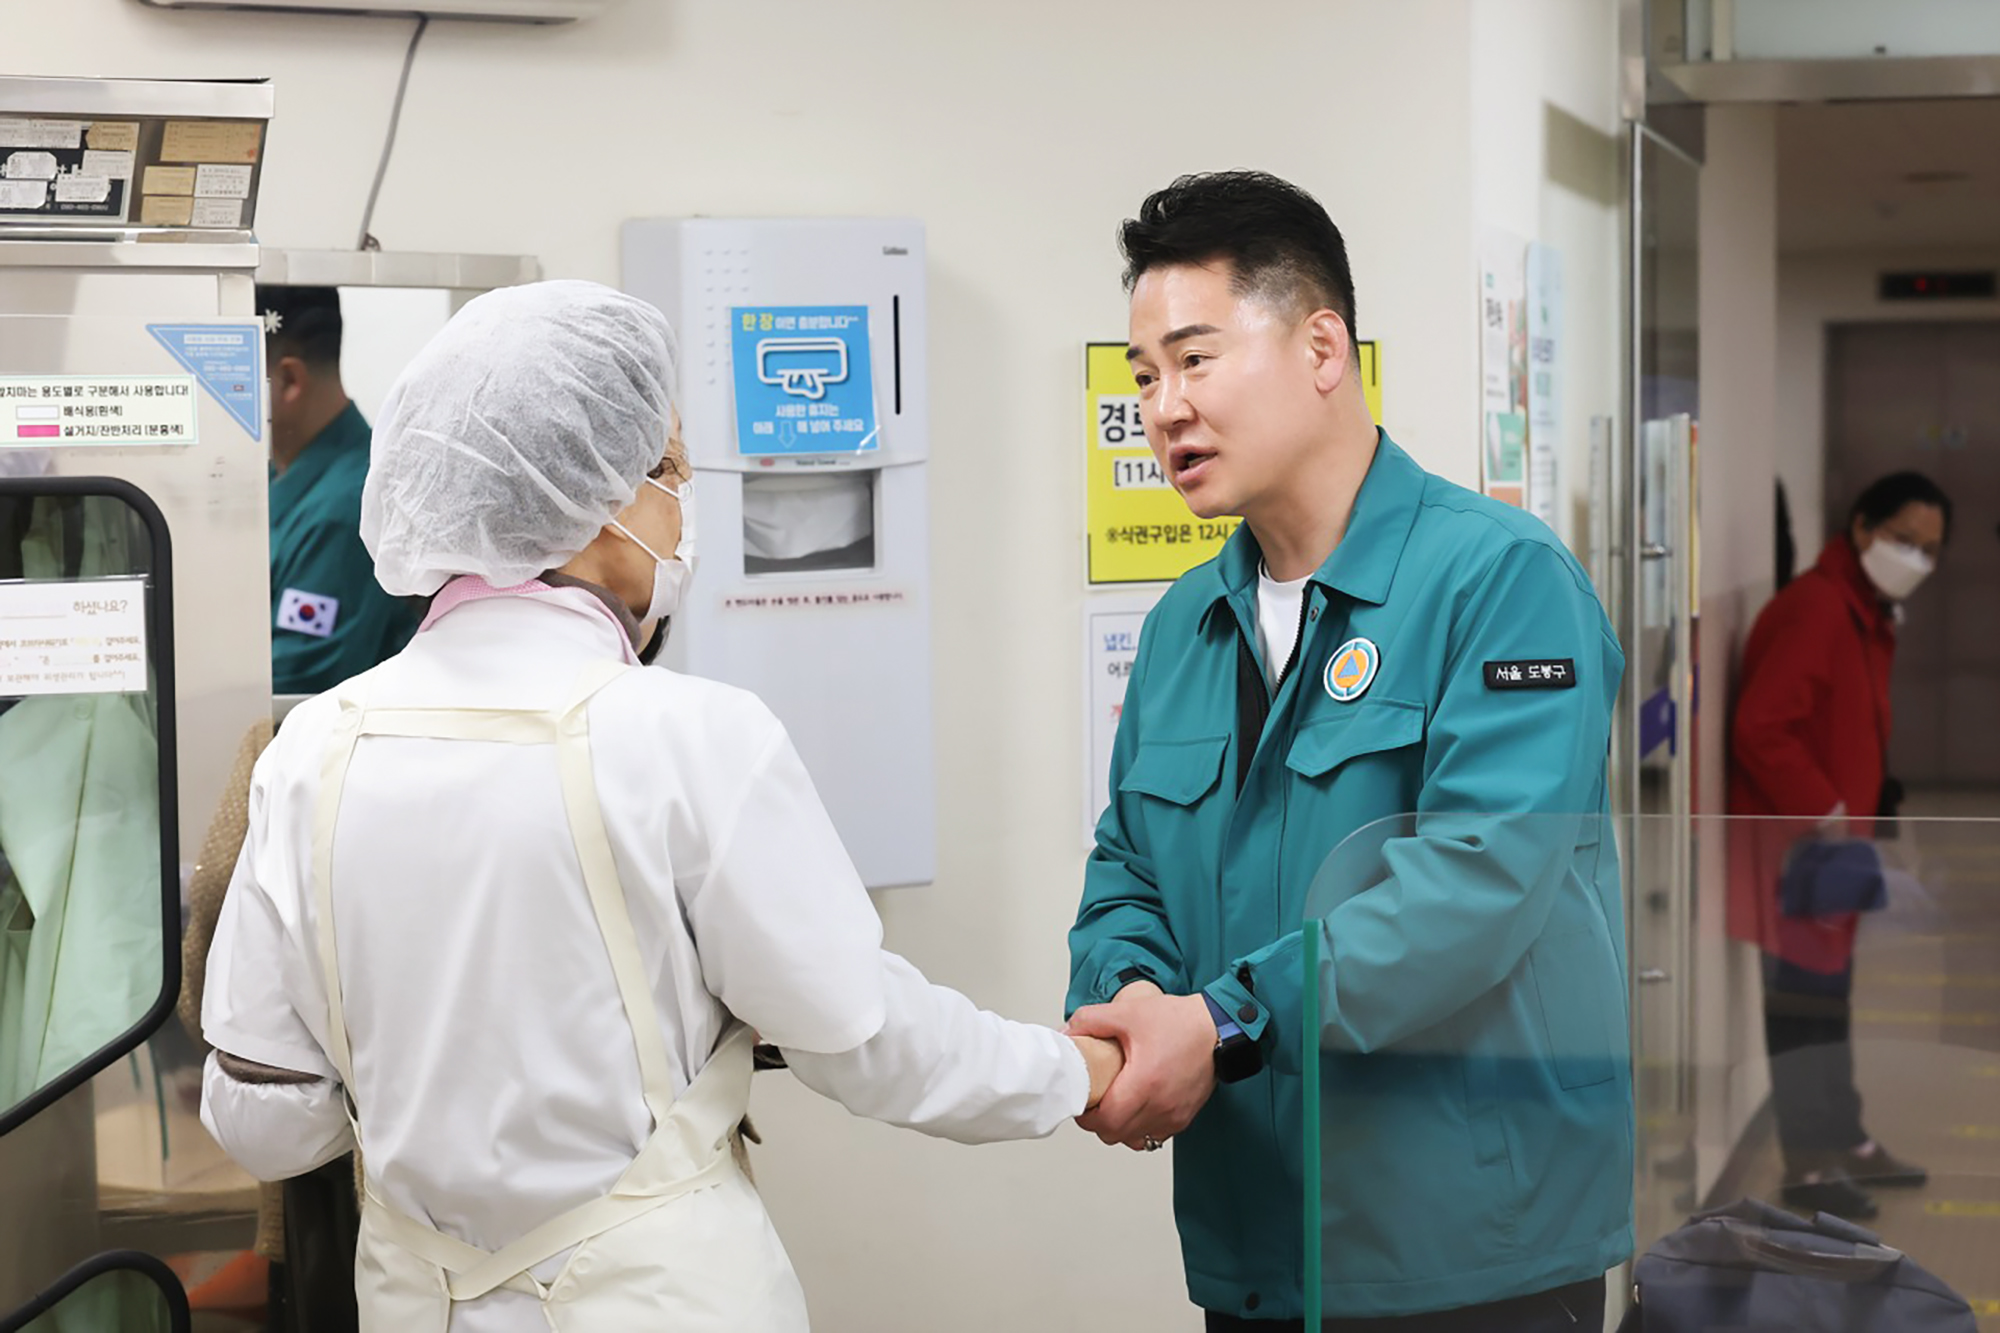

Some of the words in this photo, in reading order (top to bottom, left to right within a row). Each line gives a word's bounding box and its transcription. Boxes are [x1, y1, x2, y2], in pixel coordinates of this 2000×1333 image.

[41, 385, 84, 397] 용도별로
[88, 384, 130, 397] 구분해서
[1198, 524, 1229, 541] 12시
[1496, 665, 1523, 681] 서울
[1528, 664, 1566, 680] 도봉구
